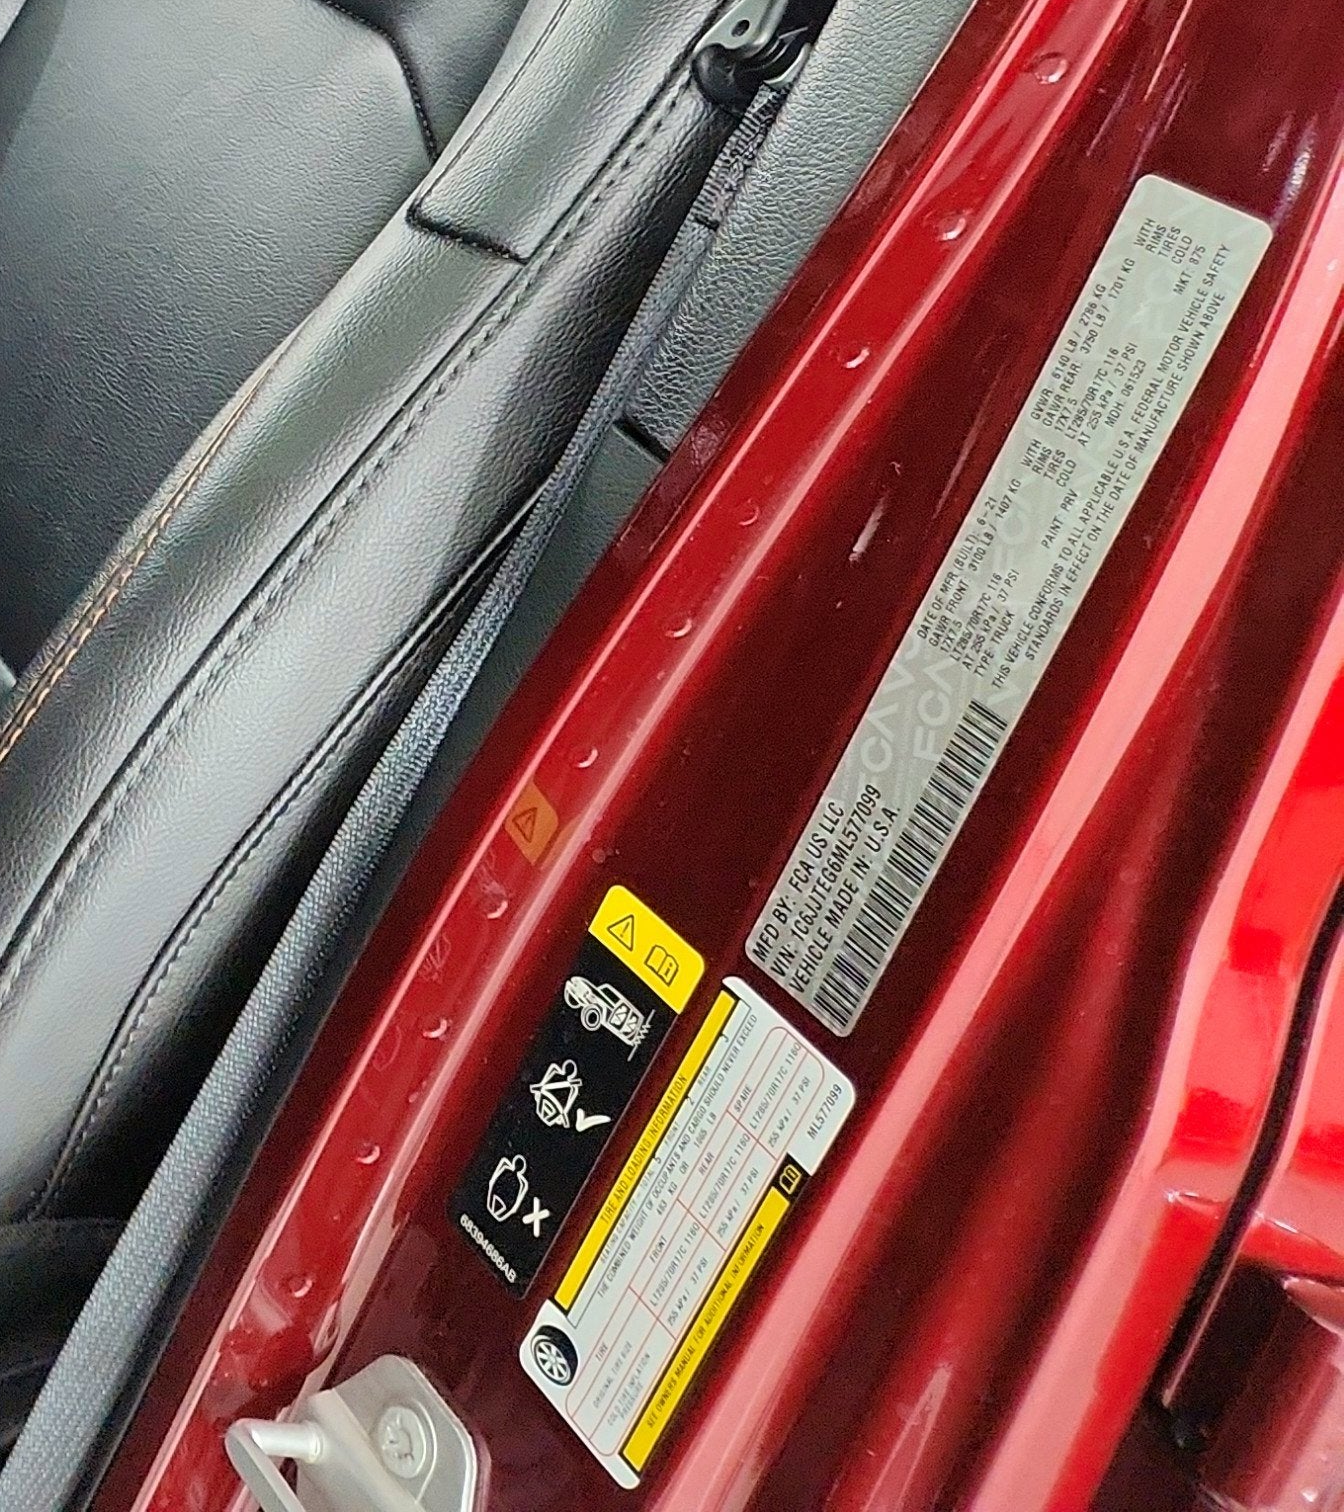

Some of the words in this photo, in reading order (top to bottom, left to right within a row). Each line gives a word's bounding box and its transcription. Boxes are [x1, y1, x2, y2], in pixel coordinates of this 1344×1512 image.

[1143, 222, 1168, 254] RIMS
[1156, 224, 1183, 260] TIRES
[1040, 392, 1066, 428] GAWR
[1091, 311, 1108, 328] LB
[1119, 255, 1136, 274] KG
[1132, 216, 1157, 248] WITH
[1062, 337, 1079, 354] LB
[1090, 281, 1107, 300] KG
[1118, 357, 1148, 398] 061523
[1186, 242, 1208, 266] 875
[1197, 290, 1227, 330] ABOVE
[1075, 430, 1092, 447] AT
[1169, 233, 1194, 265] COLD
[1174, 328, 1207, 373] SHOWN
[1131, 370, 1184, 455] MANUFACTURE
[990, 662, 1012, 691] THIS
[1003, 619, 1034, 665] VEHICLE
[1026, 561, 1065, 622] CONFORMS
[1057, 545, 1073, 563] TO
[1065, 523, 1085, 547] ALL
[1076, 458, 1119, 525] APPLICABLE
[1129, 373, 1164, 425] FEDERAL
[1155, 333, 1185, 374] MOTOR
[1176, 286, 1210, 335] VEHICLE
[1200, 242, 1233, 288] SAFETY
[1030, 444, 1053, 475] RIMS
[1042, 447, 1067, 482] TIRES
[1107, 469, 1132, 502] DATE
[1122, 451, 1141, 472] OF
[1085, 523, 1104, 543] ON
[1094, 499, 1116, 525] THE
[927, 613, 952, 648] GAWR
[966, 545, 987, 573] 3100
[979, 530, 995, 547] LB
[993, 492, 1014, 520] 1407
[1006, 476, 1022, 495] KG
[1019, 437, 1043, 469] WITH
[960, 652, 976, 671] AT
[1054, 456, 1078, 489] COLD
[989, 608, 1016, 647] TRUCK
[1058, 486, 1080, 513] PRV
[1064, 541, 1094, 584] EFFECT
[929, 593, 946, 613] OF
[937, 569, 958, 596] MFR
[1056, 581, 1073, 598] IN
[915, 609, 938, 641] DATE
[1022, 595, 1065, 662] STANDARDS
[751, 920, 782, 965] MFD
[770, 890, 797, 926] BY:
[786, 855, 816, 895] FCA
[803, 829, 829, 861] US
[816, 798, 845, 835] LLC
[769, 938, 800, 982] VIN:
[788, 780, 882, 944] 1C6JJTEG6ML577099
[788, 924, 834, 998] VEHICLE
[822, 875, 860, 931] MADE
[847, 848, 874, 881] IN:
[861, 796, 901, 855] U.S.A.
[805, 1081, 843, 1141] ML577099
[599, 1198, 617, 1226] TIRE
[611, 1177, 629, 1204] AND
[622, 1135, 652, 1183] LOADING
[645, 1071, 688, 1141] INFORMATION
[676, 1131, 692, 1154] AND
[460, 1213, 517, 1284] 68394686AB
